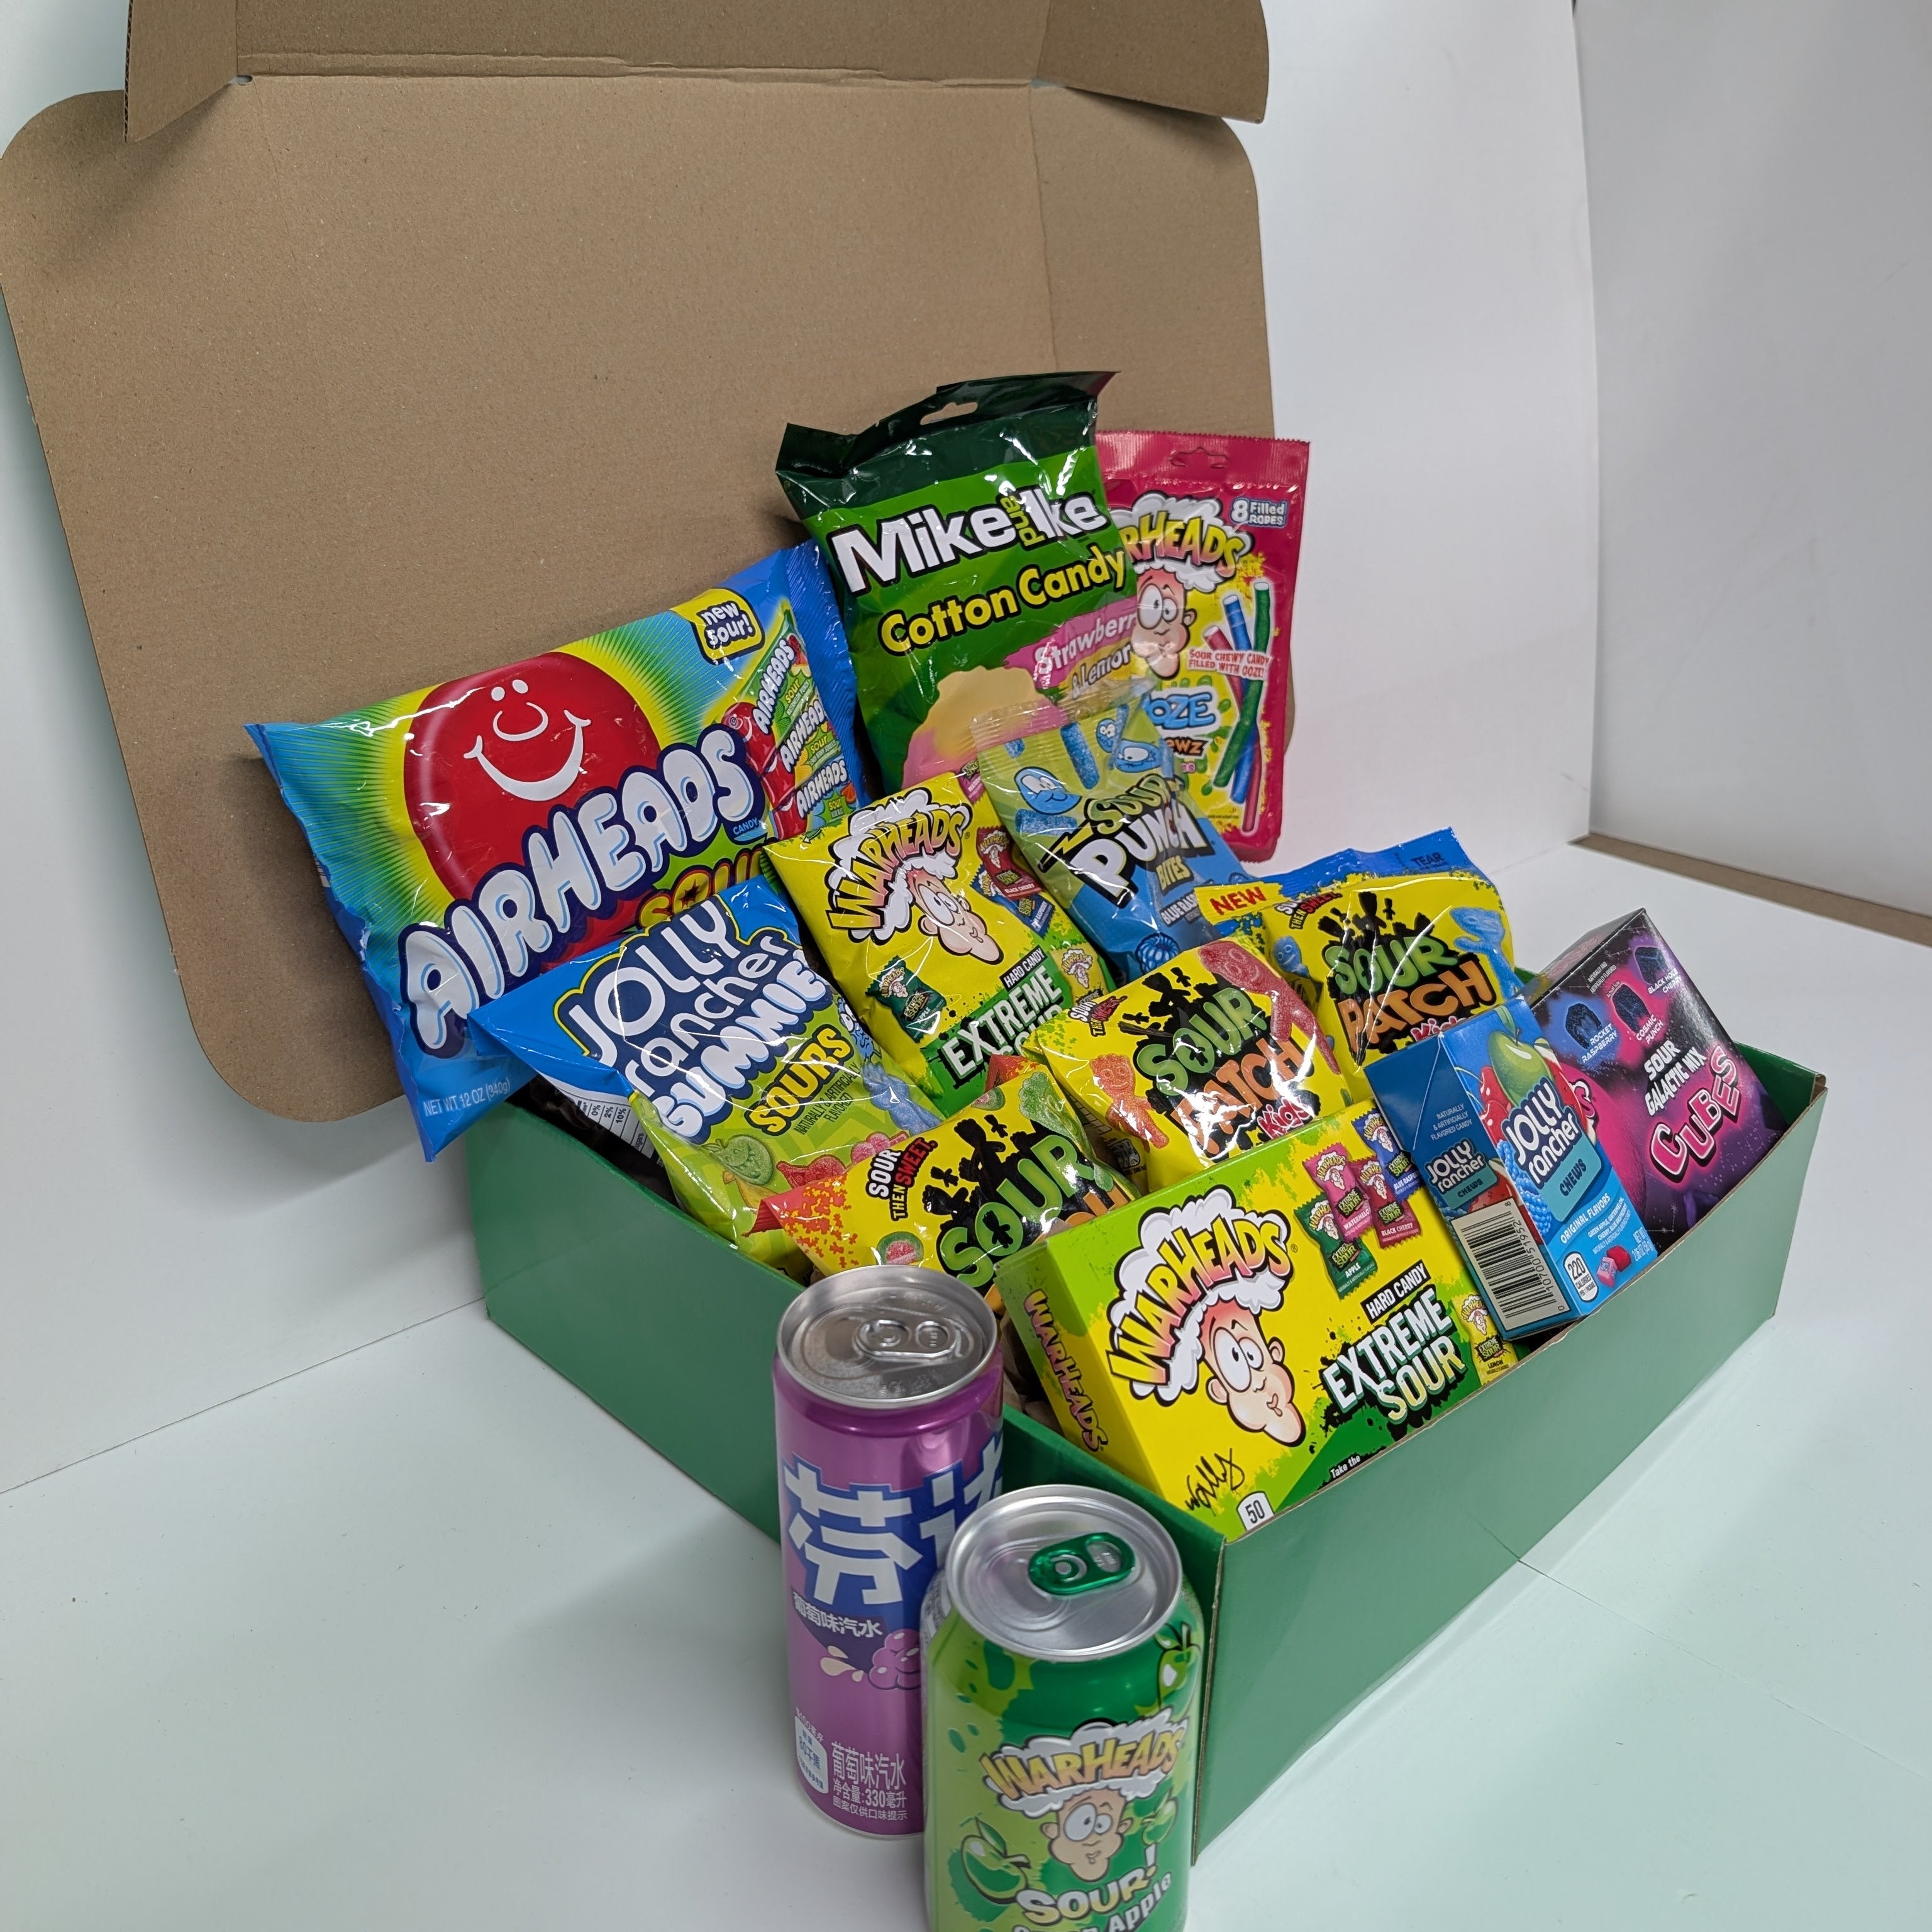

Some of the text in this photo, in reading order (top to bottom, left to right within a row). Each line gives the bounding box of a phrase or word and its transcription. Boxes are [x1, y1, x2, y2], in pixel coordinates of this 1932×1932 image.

[1231, 499, 1286, 524] 8 Filled
[1248, 514, 1284, 526] ROPES
[829, 488, 1109, 595] Mike and Ike
[1119, 510, 1245, 578] RHEADS
[701, 602, 740, 626] new
[881, 546, 1126, 654] Cotton Candy
[707, 619, 753, 648] sour!
[1033, 612, 1138, 675] Strawberr
[1189, 649, 1270, 667] SOUR CHEWY CANDY
[1189, 658, 1264, 678] FILLED WITH OOZE!
[753, 638, 796, 735] AIRHEADS
[1146, 692, 1216, 730] OZE
[780, 699, 829, 773] AIRHEAD
[796, 758, 848, 818] AIRHEADS
[1087, 776, 1171, 835] SOUR
[732, 817, 760, 837] CANDY
[1069, 803, 1208, 899] PUNCH
[1410, 852, 1445, 867] TEAR
[825, 808, 965, 930] WARHEADS
[1155, 855, 1191, 892] BITES
[404, 728, 755, 1050] AIRHEADS
[1209, 886, 1267, 916] NEW
[1160, 906, 1184, 924] BLUE
[1291, 909, 1307, 928] THEN
[1003, 947, 1045, 988] HARD CANDY
[1324, 936, 1459, 995] SOUR
[1587, 968, 1602, 984] NATURALLY
[1646, 967, 1679, 995] BLACK HOLE
[568, 899, 741, 1069] JOLLY
[1606, 980, 1621, 999] Actual Size
[1662, 975, 1682, 994] CHERRY
[625, 935, 791, 1097] rancher
[916, 1007, 931, 1024] APPLE
[944, 965, 1063, 1077] EXTREME
[1070, 1001, 1096, 1023] SOUR
[1337, 960, 1494, 1054] PATCH
[650, 949, 829, 1137] GUMMIE
[1135, 987, 1267, 1097] SOUR
[1589, 1023, 1613, 1046] ROCKET
[1635, 1013, 1657, 1041] COSMIC
[1645, 1019, 1664, 1045] PUNCH
[1580, 1030, 1618, 1063] RASPBERRY
[1643, 1040, 1682, 1082] SOUR
[422, 1076, 511, 1117] NET WT 12 OZ (340g)
[748, 1027, 852, 1133] SOURS
[1644, 1063, 1690, 1118] GALACTIC
[1681, 1045, 1707, 1082] MIX
[591, 1104, 601, 1116] 0%
[604, 1106, 614, 1119] 2%
[793, 1104, 825, 1135] NATURALLY
[825, 1062, 861, 1102] ARTIFICIALLY
[823, 1092, 853, 1123] FLAVORED
[1436, 1103, 1465, 1120] NATURALLY
[1649, 1045, 1742, 1177] CUBES
[615, 1108, 627, 1124] 10%
[1430, 1119, 1472, 1141] FLAVORED CANDY
[1437, 1111, 1468, 1129] ARTIFICIALLY
[1506, 1081, 1565, 1159] JOLLY
[1426, 1141, 1474, 1185] JOLLY
[1528, 1113, 1580, 1185] rancher
[869, 1149, 901, 1197] SOUR
[892, 1138, 936, 1219] THEN SWEET.
[1317, 1155, 1346, 1180] WARHEADS
[1359, 1163, 1382, 1184] WARHE
[1393, 1157, 1409, 1177] SOUR
[1437, 1155, 1484, 1192] rancher
[1558, 1158, 1587, 1196] CHEWS
[1337, 1188, 1359, 1212] EXTREME
[1457, 1178, 1484, 1198] CHEWS
[940, 1134, 1095, 1289] SOUR
[1342, 1194, 1363, 1216] SOUR
[1378, 1201, 1400, 1217] EXTREME
[1382, 1208, 1403, 1224] SOUR
[1560, 1211, 1589, 1245] ORIGINAL
[1587, 1192, 1611, 1221] FLAVORS
[1380, 1227, 1396, 1237] BLACK
[1396, 1222, 1414, 1232] CHERRY
[1512, 1221, 1535, 1255] 51952
[1336, 1245, 1358, 1269] SOUR
[1344, 1262, 1361, 1279] APPLE
[1567, 1257, 1586, 1281] 220
[1365, 1291, 1396, 1320] HARD
[1393, 1262, 1429, 1299] CANDY
[1531, 1258, 1555, 1291] 10700
[1575, 1273, 1592, 1290] CALORIES
[1106, 1214, 1292, 1385] WARHEADS
[1322, 1288, 1453, 1413] EXTREME
[1478, 1336, 1499, 1353] EXTREME
[1482, 1343, 1502, 1359] SOUR
[1023, 1290, 1109, 1452] WARHEADS
[1375, 1335, 1467, 1421] SOUR
[1487, 1359, 1504, 1369] LEMON
[1330, 1454, 1361, 1479] Take the
[1245, 1499, 1265, 1524] 50
[792, 1591, 884, 1638] 葡萄味汽水
[831, 1740, 906, 1790] 葡萄味汽水
[979, 1726, 1186, 1801] WARHEADS
[833, 1795, 908, 1821] 图案仅供口味提示
[1015, 1842, 1158, 1926] SOUR!
